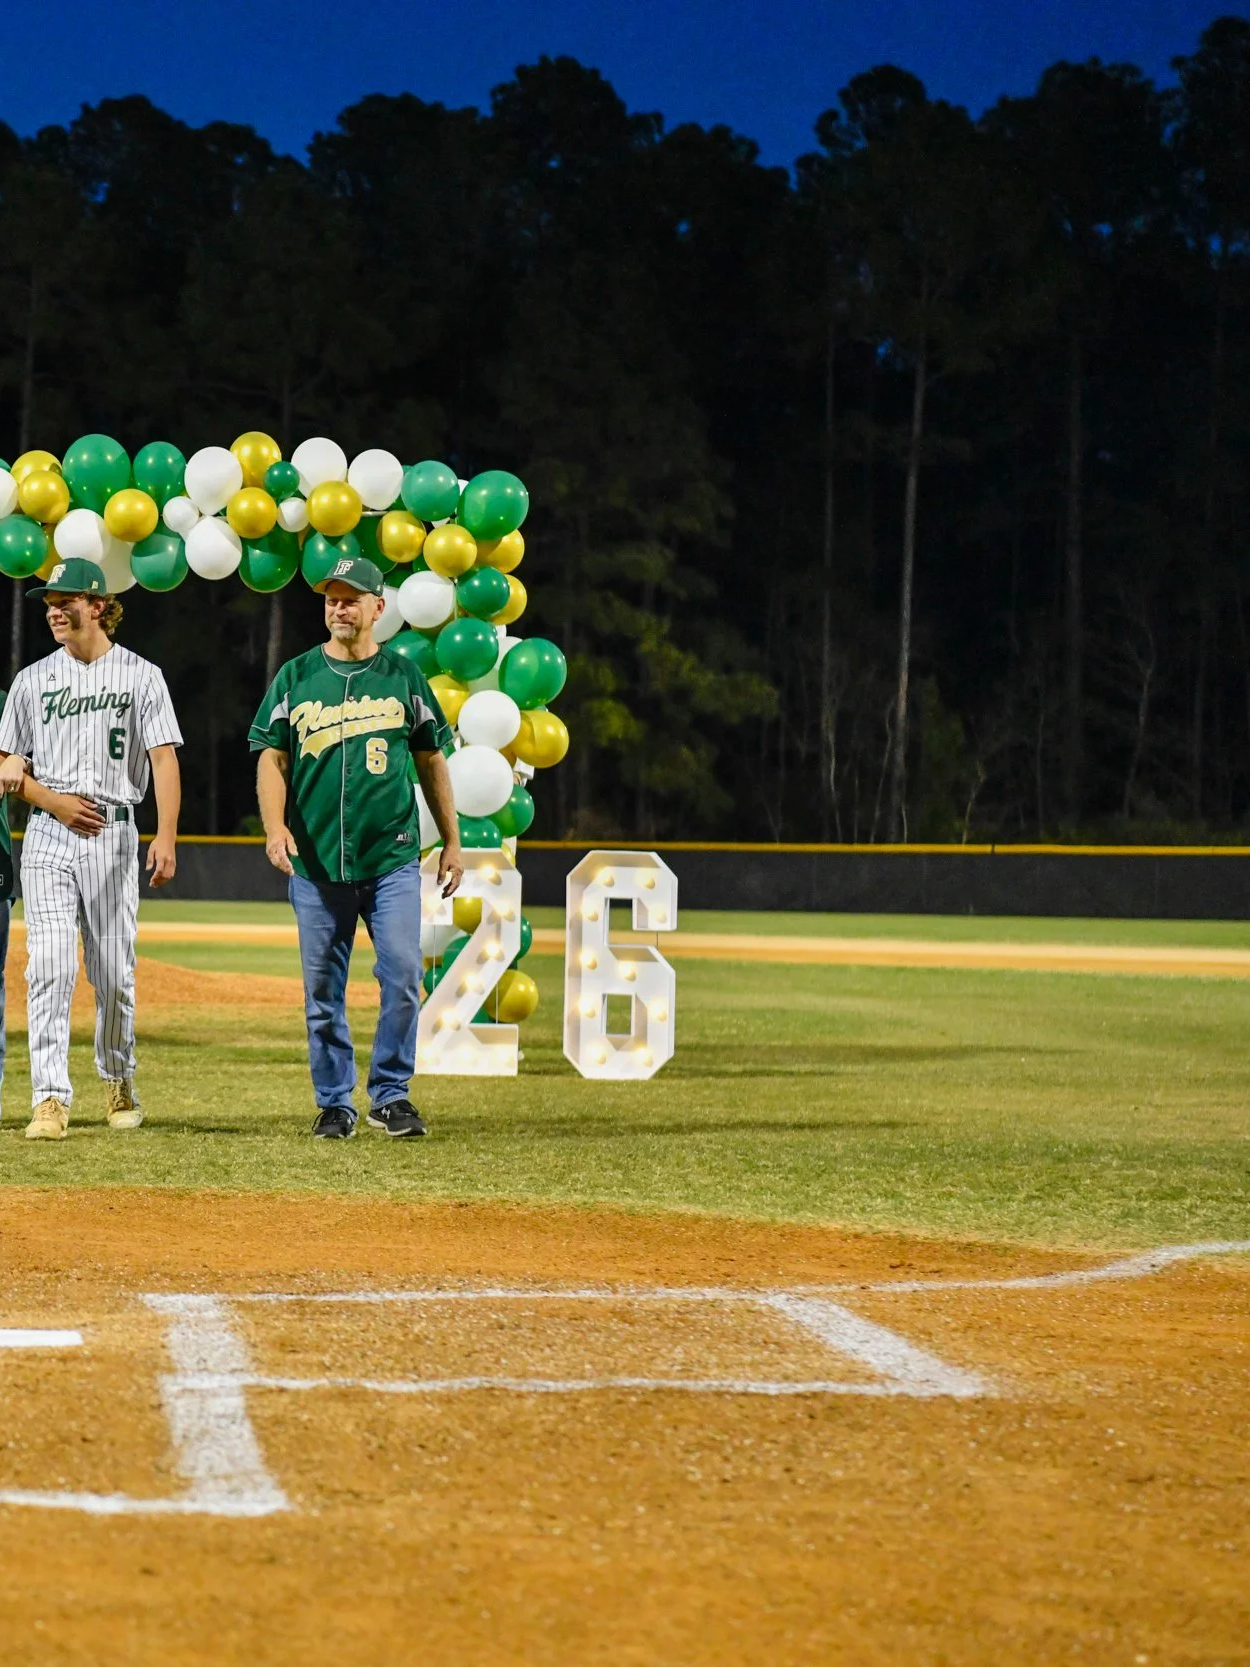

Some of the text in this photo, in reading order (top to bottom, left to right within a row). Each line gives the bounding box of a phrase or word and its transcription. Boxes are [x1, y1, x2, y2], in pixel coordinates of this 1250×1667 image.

[42, 686, 133, 724] Fleming
[109, 727, 126, 760] 6
[365, 736, 389, 775] 6
